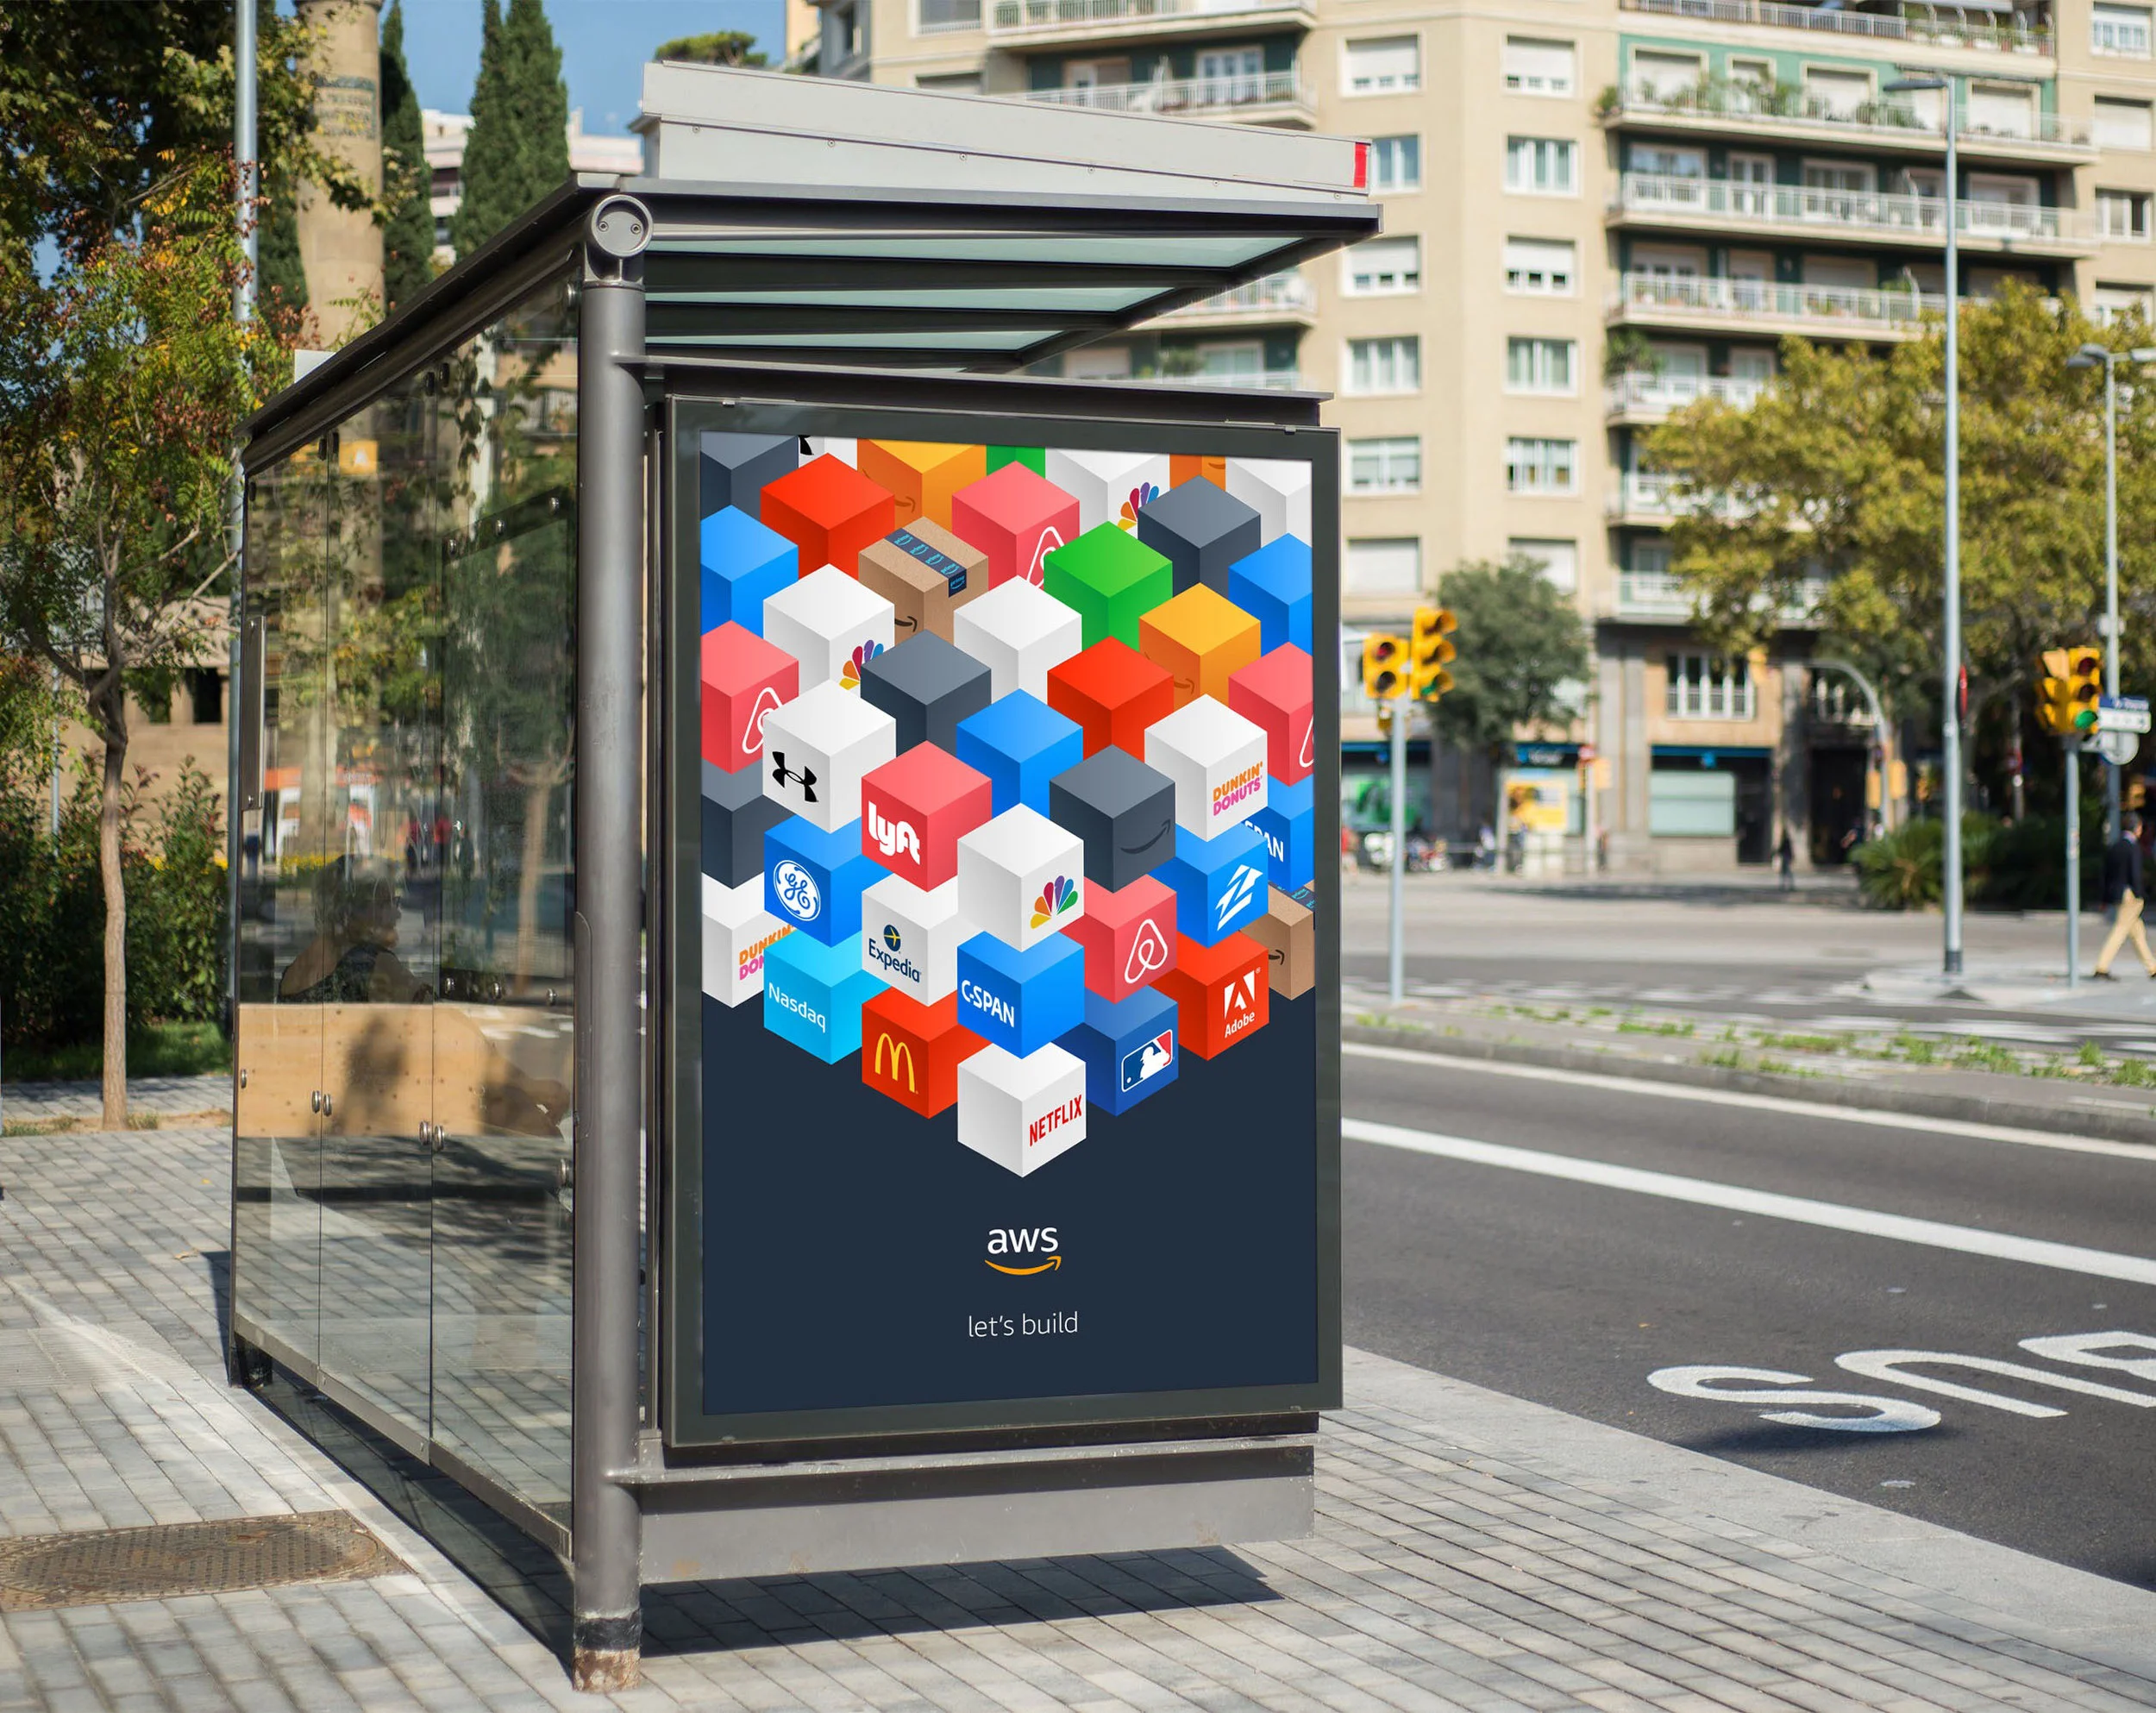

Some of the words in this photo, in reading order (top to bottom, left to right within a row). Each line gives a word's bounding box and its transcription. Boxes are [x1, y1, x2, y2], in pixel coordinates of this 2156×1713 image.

[1213, 761, 1263, 802] DUNKIN'
[1213, 776, 1262, 817] DONUTS
[868, 800, 920, 865] lyft
[739, 924, 793, 965] DUNKIN
[868, 938, 920, 983] Expedia
[768, 982, 826, 1034] Nasdaq
[961, 979, 1015, 1028] C-SPAN
[1225, 1011, 1256, 1038] Adobe
[1029, 1094, 1082, 1147] NETFLIX
[987, 1227, 1059, 1254] aws
[968, 1315, 1015, 1338] let's
[1022, 1310, 1079, 1335] build
